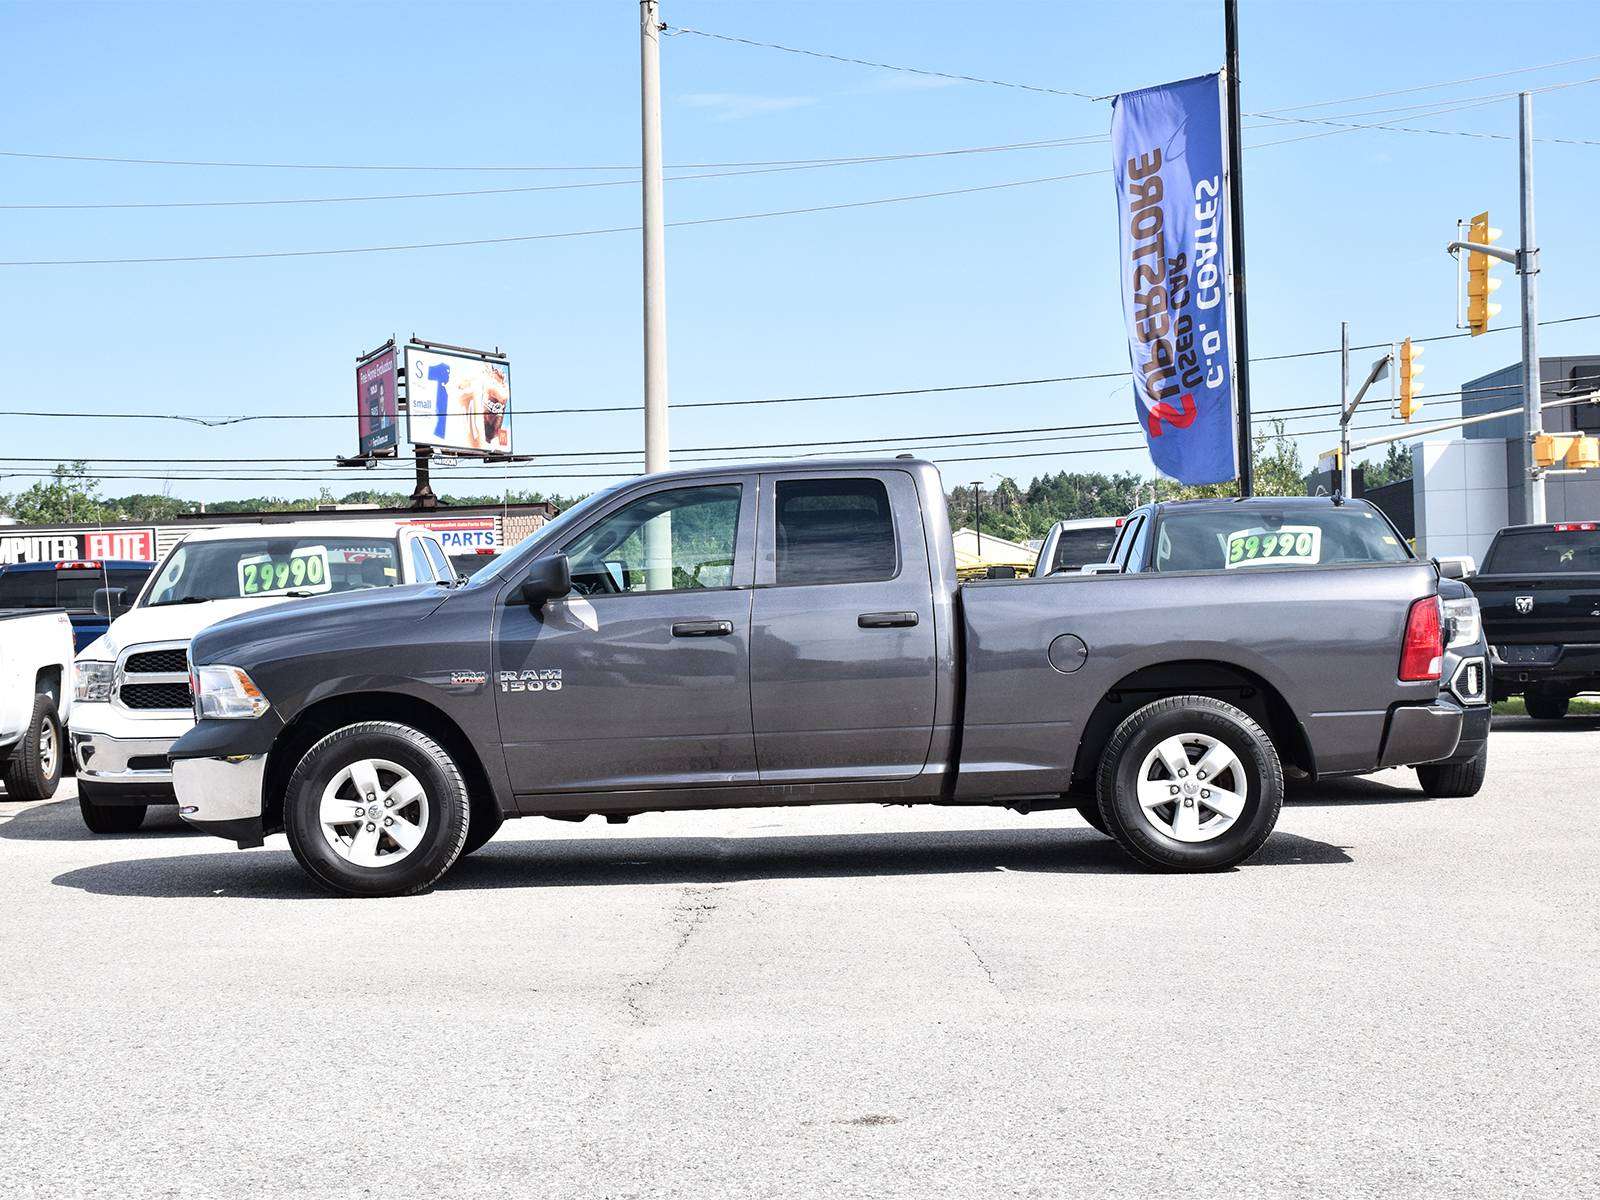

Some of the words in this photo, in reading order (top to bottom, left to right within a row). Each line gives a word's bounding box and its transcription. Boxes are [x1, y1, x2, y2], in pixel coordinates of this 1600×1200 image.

[412, 399, 432, 409] small
[441, 531, 494, 546] PARTS
[90, 534, 146, 561] ELITE
[1230, 533, 1312, 562] 39990
[244, 555, 324, 593] 29990
[500, 669, 562, 681] RAM
[500, 680, 562, 692] 1500
